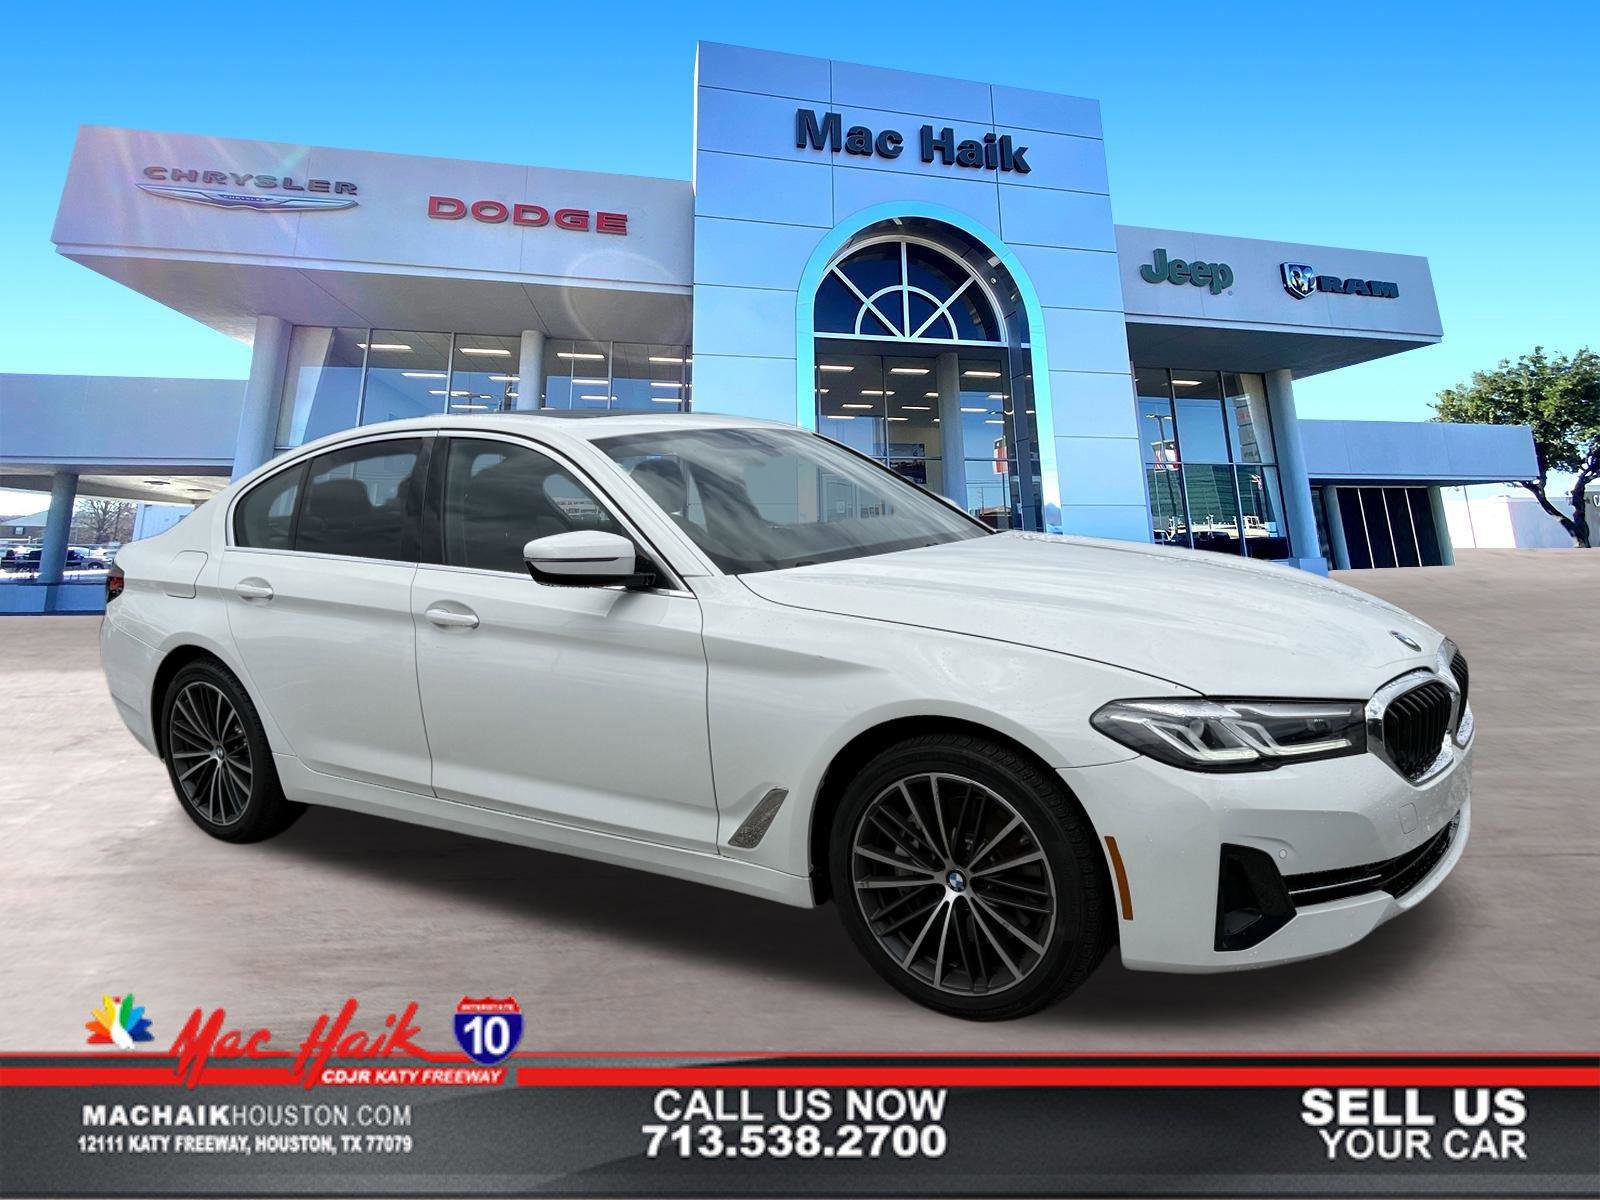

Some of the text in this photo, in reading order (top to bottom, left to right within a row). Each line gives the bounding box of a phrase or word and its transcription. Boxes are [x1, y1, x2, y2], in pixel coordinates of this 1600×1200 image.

[796, 108, 1032, 174] Mac Haik
[143, 166, 358, 196] CHRYSLER
[428, 196, 628, 236] DODGE
[1140, 248, 1234, 295] Jeep
[1316, 275, 1399, 299] RAM
